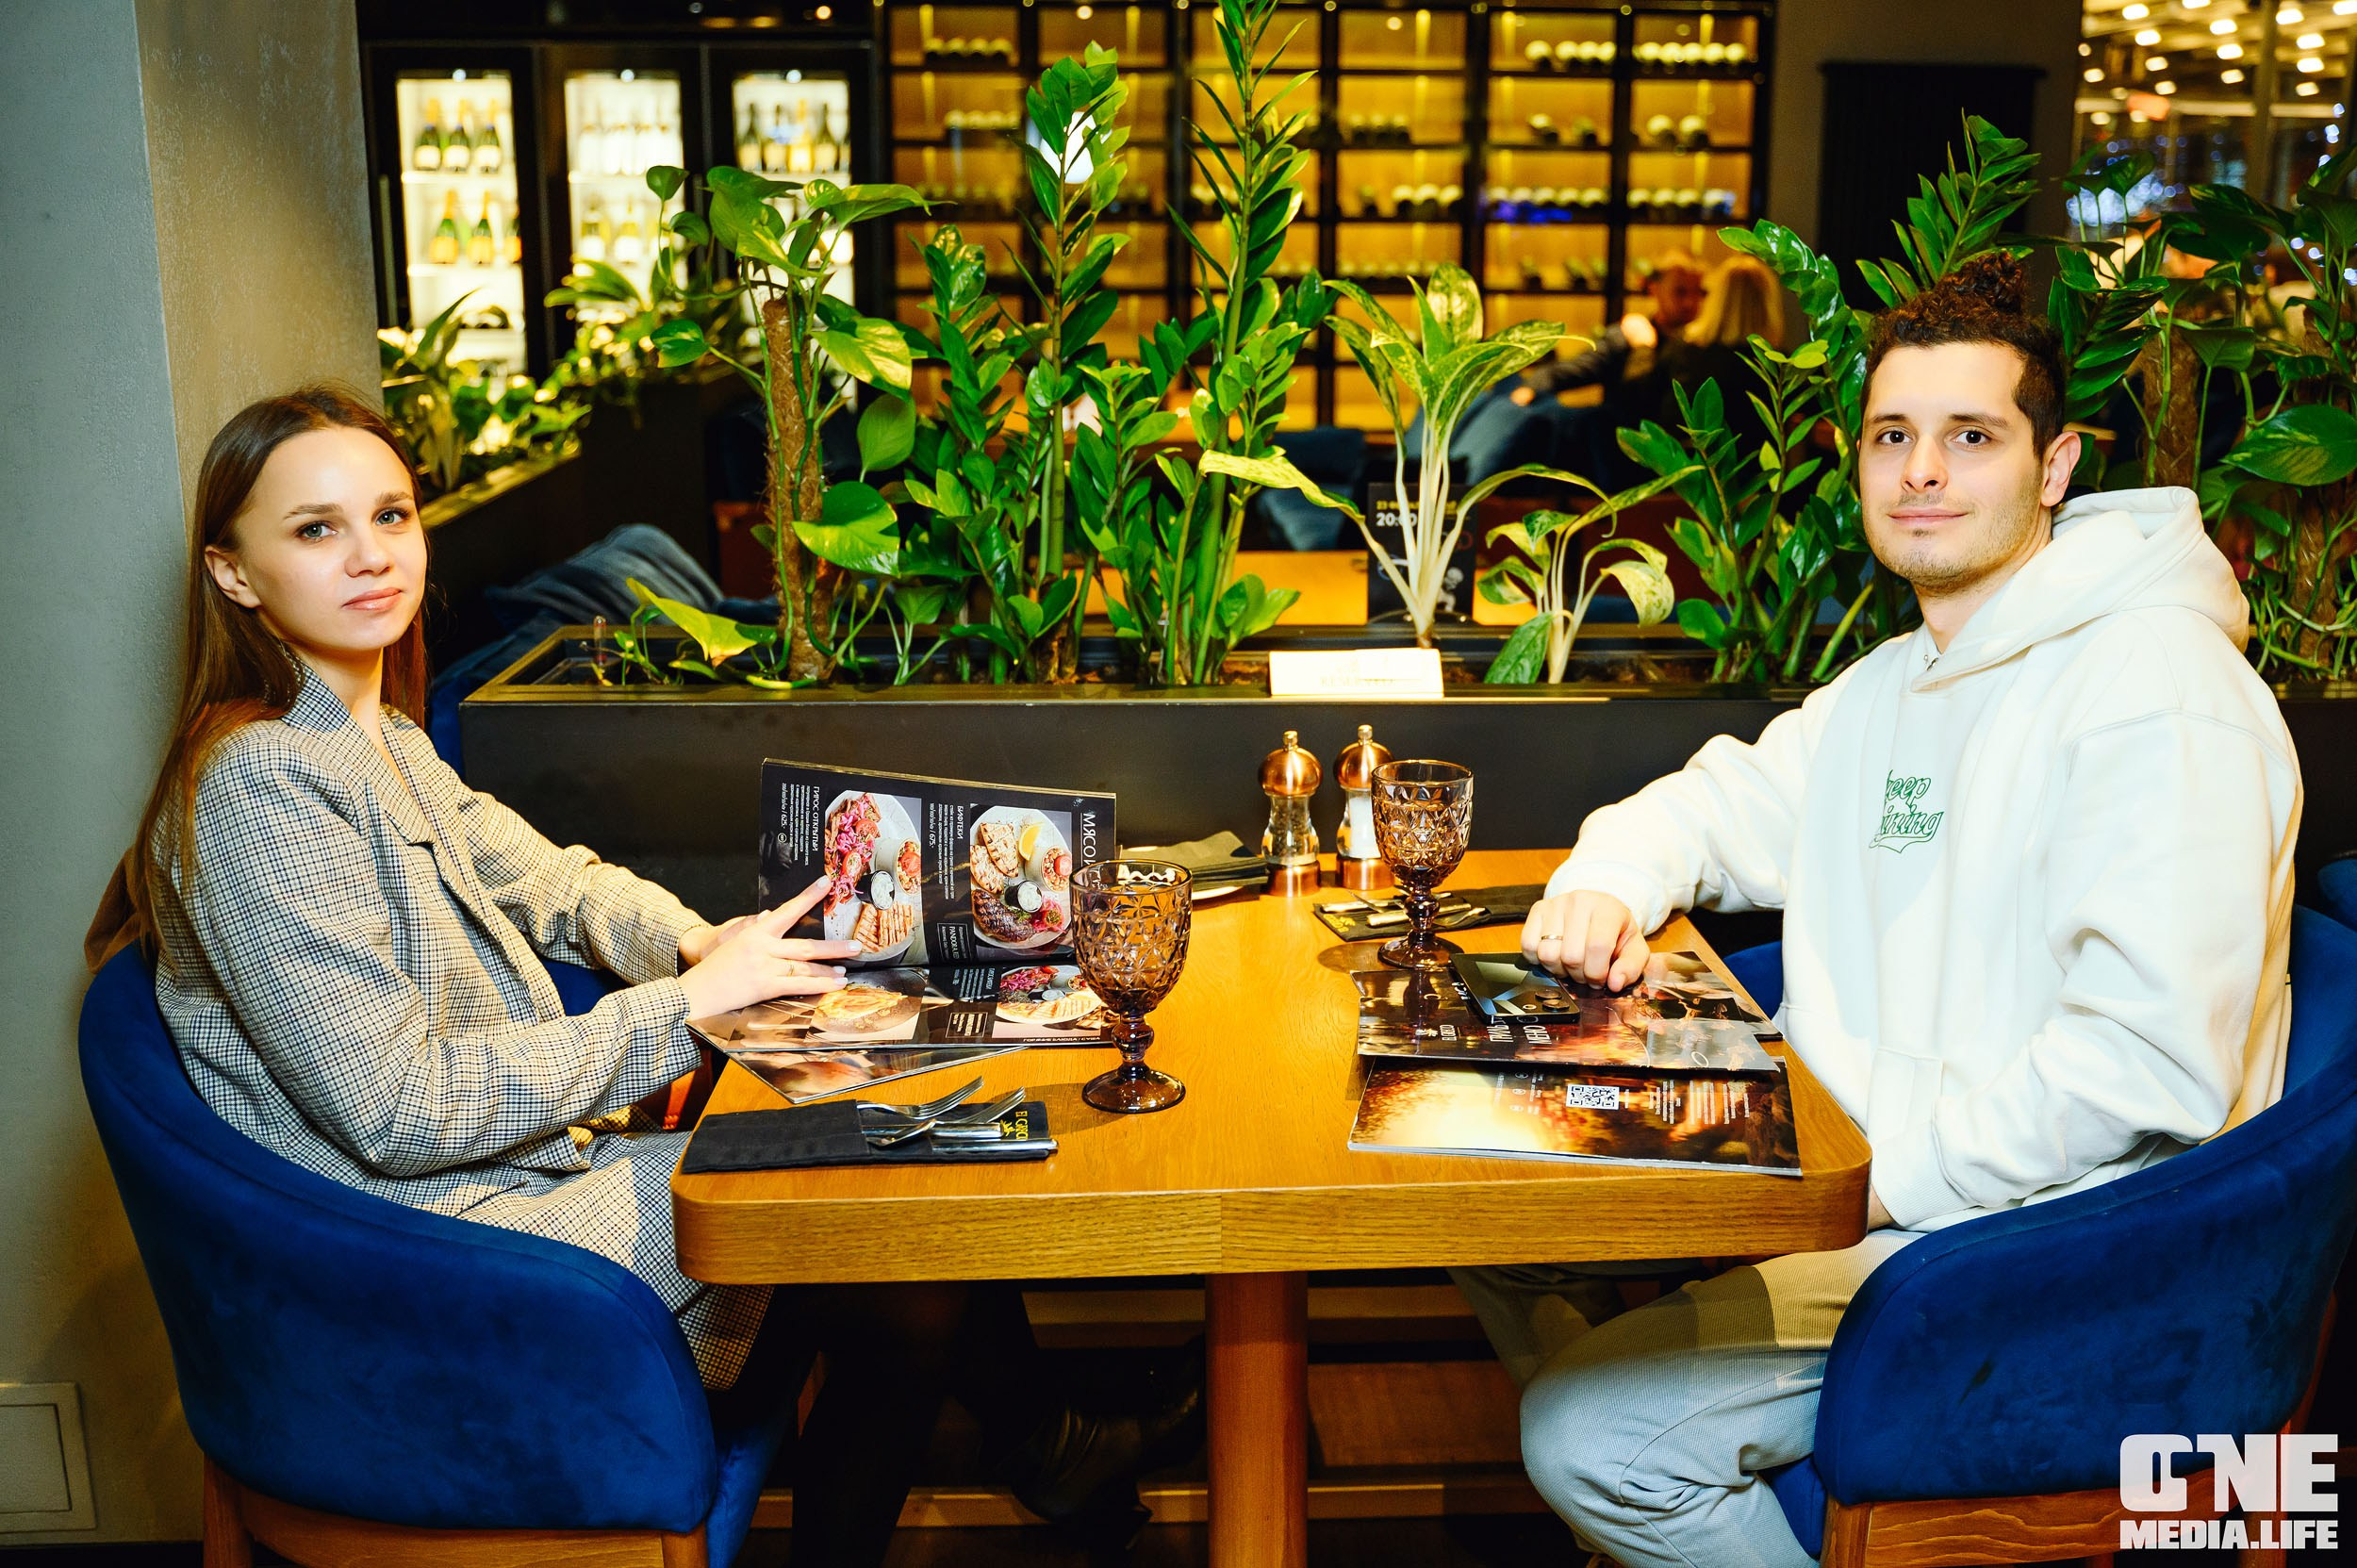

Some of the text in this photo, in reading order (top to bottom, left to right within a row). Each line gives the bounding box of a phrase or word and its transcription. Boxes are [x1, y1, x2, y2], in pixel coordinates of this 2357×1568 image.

[1376, 512, 1417, 526] 20:0
[1083, 813, 1096, 858] МЯСО
[1881, 804, 1945, 840] ining
[1523, 1025, 1553, 1045] МЕНЮ
